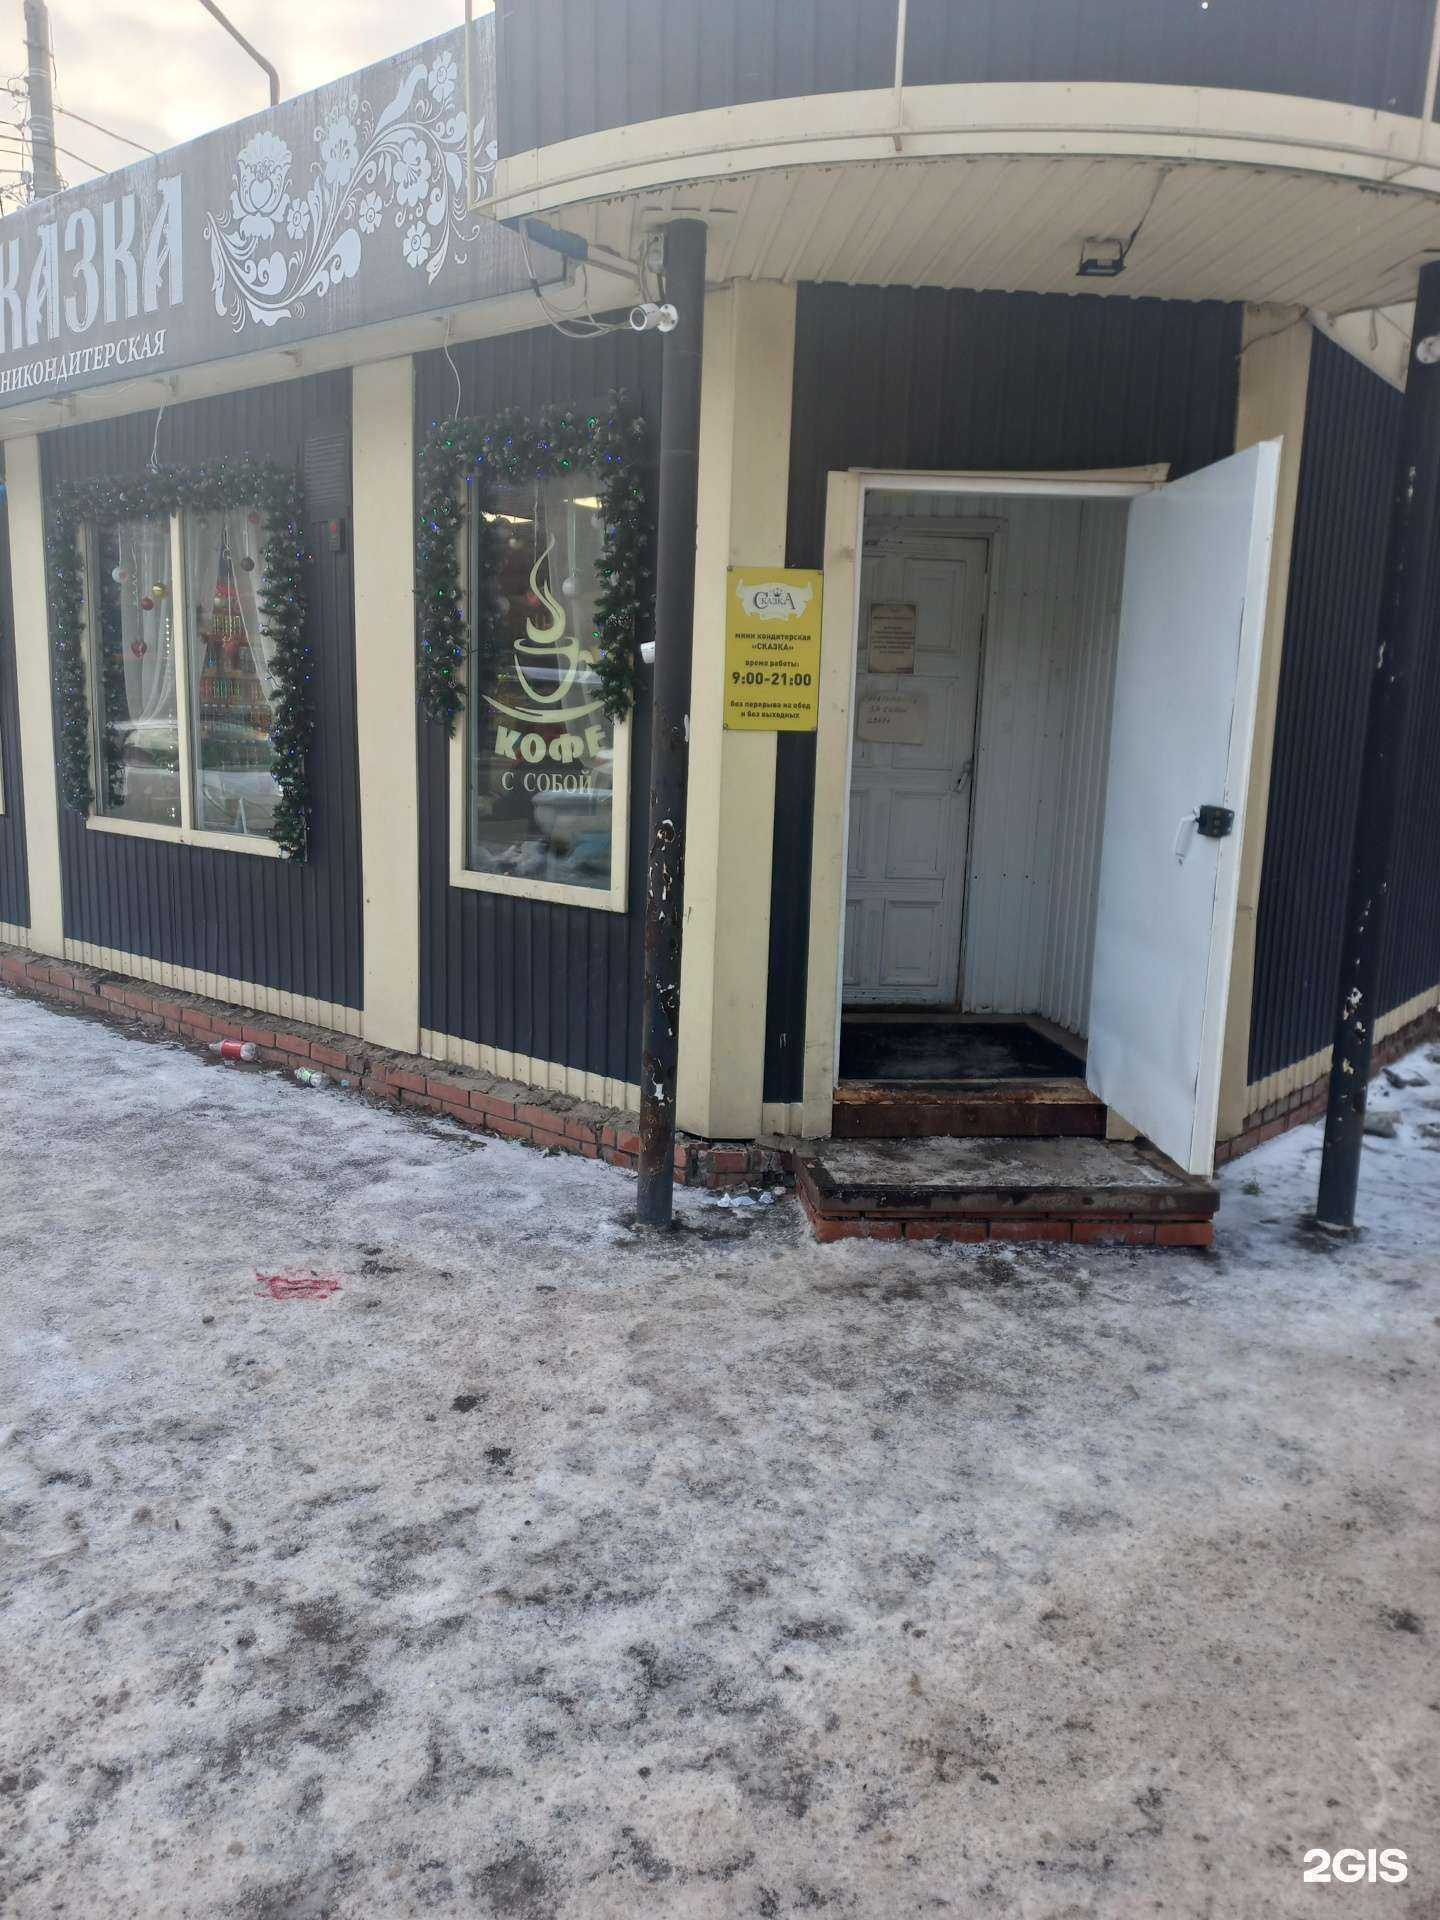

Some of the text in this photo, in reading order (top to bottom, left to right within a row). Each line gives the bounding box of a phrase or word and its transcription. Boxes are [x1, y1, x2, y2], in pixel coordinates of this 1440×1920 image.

[732, 671, 812, 687] 9:00-21:00
[494, 724, 606, 764] КОФЕ
[523, 769, 593, 795] СОБОЙ
